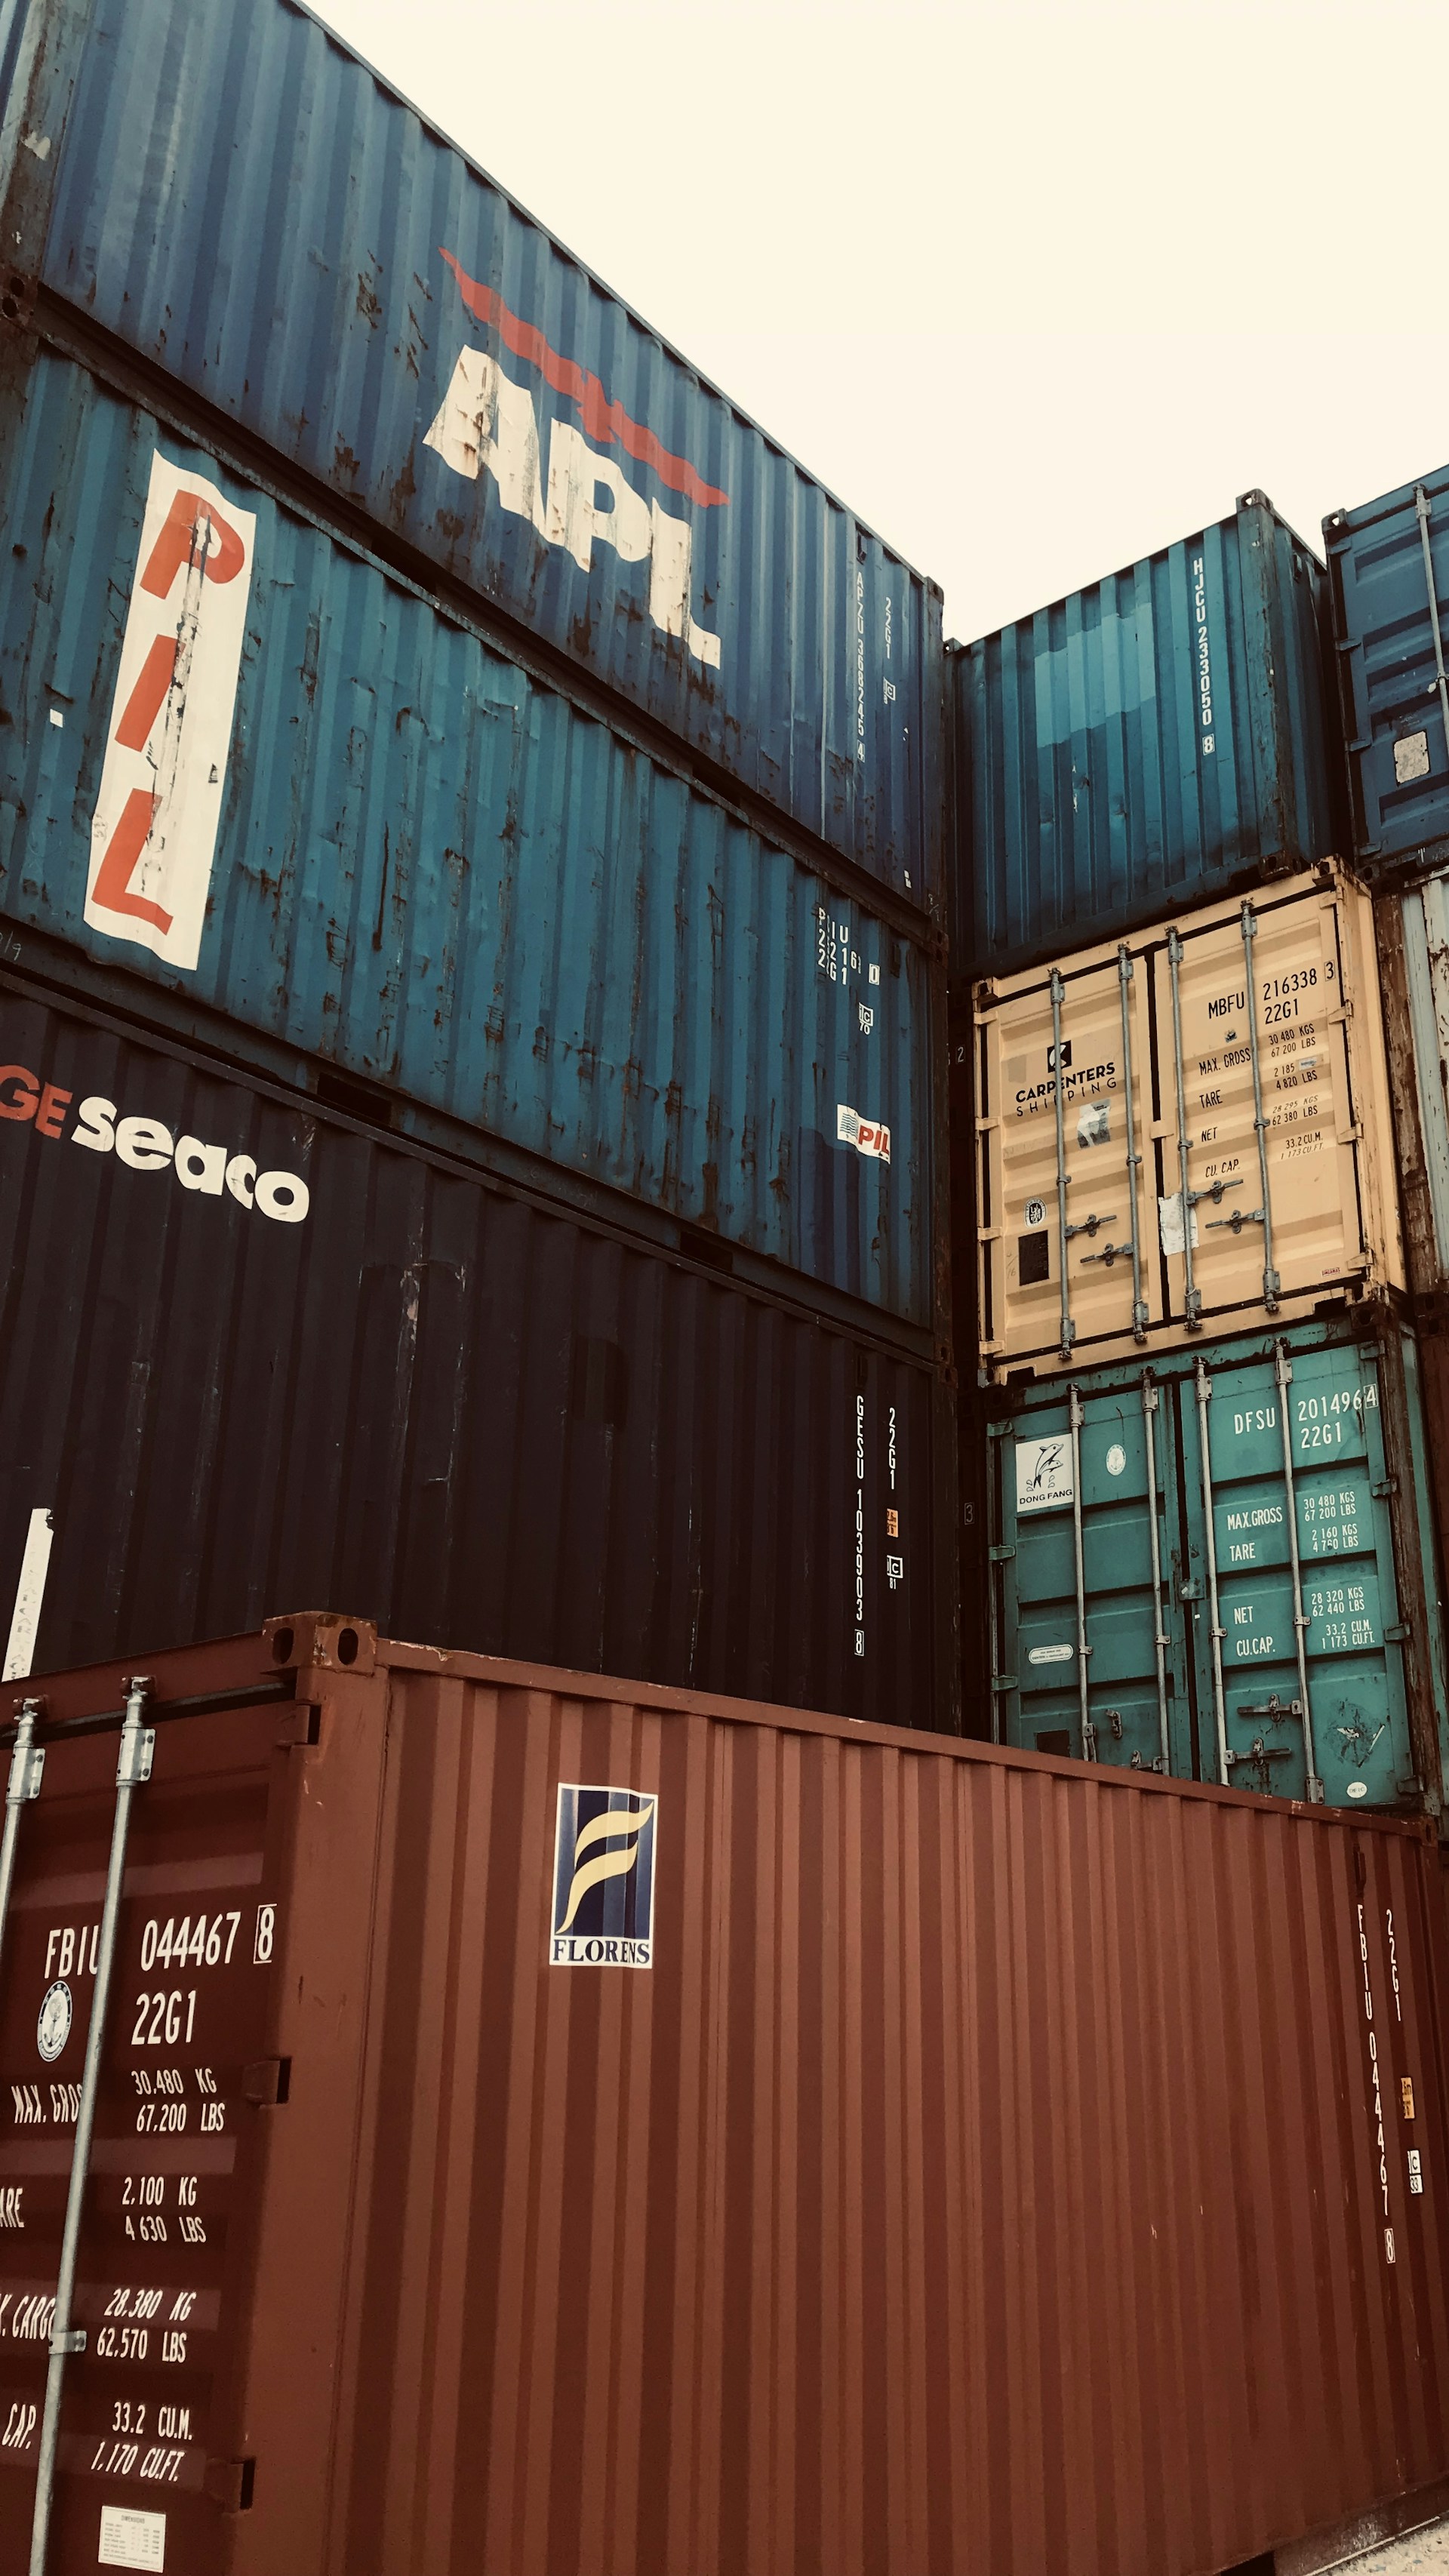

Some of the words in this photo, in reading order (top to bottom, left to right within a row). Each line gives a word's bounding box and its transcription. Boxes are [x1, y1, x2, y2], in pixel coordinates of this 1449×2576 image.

[422, 344, 721, 669] APL
[1193, 558, 1206, 623] HJCU
[1198, 626, 1213, 725] 233050
[91, 489, 245, 936] PIL
[1204, 735, 1214, 754] 8
[1208, 991, 1244, 1019] MBFU
[1263, 968, 1317, 1001] 216338
[1324, 961, 1335, 980] 3
[1264, 999, 1298, 1025] 22G1
[1269, 1034, 1278, 1045] 30
[1281, 1029, 1295, 1042] 480
[1299, 1023, 1315, 1036] KGS
[1271, 1047, 1280, 1057] 67
[1283, 1042, 1297, 1054] 200
[1301, 1036, 1316, 1049] LBS
[1199, 1057, 1221, 1076] MAX.
[1223, 1048, 1251, 1068] GROSS
[1274, 1068, 1278, 1078] 2
[1282, 1063, 1295, 1075] 185
[1276, 1080, 1281, 1090] 4
[1284, 1076, 1297, 1088] 820
[1302, 1070, 1318, 1083] LBS
[1199, 1090, 1223, 1109] TARE
[1272, 1105, 1281, 1114] 28
[1284, 1100, 1298, 1110] 295
[1303, 1095, 1318, 1105] KGS
[1272, 1116, 1281, 1126] 62
[1284, 1111, 1298, 1122] 380
[1303, 1105, 1318, 1118] LBS
[0, 1065, 73, 1140] GE
[71, 1096, 309, 1223] seaco
[858, 1125, 890, 1154] PIL
[1201, 1127, 1218, 1143] NET
[1285, 1137, 1302, 1149] 33.2
[1303, 1131, 1323, 1145] CU.M.
[1288, 1147, 1301, 1158] 173
[1205, 1165, 1218, 1178] CU.
[1234, 1407, 1275, 1435] DFSU
[1297, 1390, 1362, 1422] 201496
[1365, 1384, 1377, 1408] 4
[1300, 1422, 1341, 1449] 22G1
[1020, 1494, 1045, 1504] DONG
[1048, 1489, 1072, 1500] FANG
[1304, 1498, 1315, 1510] 30
[1318, 1494, 1335, 1507] 480
[1340, 1491, 1355, 1504] KGS
[1304, 1510, 1315, 1522] 67
[1319, 1507, 1336, 1520] 200
[1340, 1503, 1356, 1516] LBS
[1312, 1529, 1318, 1541] 2
[1321, 1527, 1338, 1539] 160
[1342, 1523, 1358, 1536] KGS
[1312, 1541, 1318, 1553] 4
[1343, 1535, 1358, 1548] LBS
[1229, 1542, 1256, 1562] TARE
[1312, 1593, 1323, 1605] 28
[1326, 1589, 1344, 1603] 320
[1347, 1586, 1364, 1599] KGS
[1312, 1605, 1324, 1617] 62
[1327, 1602, 1344, 1615] 440
[1349, 1599, 1365, 1612] LBS
[1234, 1605, 1254, 1625] NET
[1325, 1622, 1346, 1636] 33.2
[1351, 1619, 1372, 1633] CU.M.
[856, 1630, 863, 1655] 8
[1331, 1635, 1348, 1648] 173
[1352, 1631, 1375, 1645] CU.FT.
[141, 1911, 241, 1972] 044467
[255, 1905, 275, 1962] 8
[552, 1939, 651, 1964] FLORENS
[1386, 1909, 1401, 2021] 22G1
[131, 1989, 196, 2045] 22G1
[195, 2068, 217, 2094] KG
[1357, 1904, 1374, 2020] FBIU
[1368, 2031, 1389, 2216] 044467
[1385, 2230, 1395, 2263] 8
[200, 2102, 226, 2131] LBS
[178, 2176, 198, 2206] KG
[125, 2215, 136, 2241] 4
[140, 2216, 168, 2242] 630
[179, 2217, 207, 2243] LBS
[169, 2291, 197, 2322] KG
[162, 2331, 187, 2363] LBS
[112, 2402, 146, 2434] 33.2
[158, 2407, 192, 2441] CU.M.
